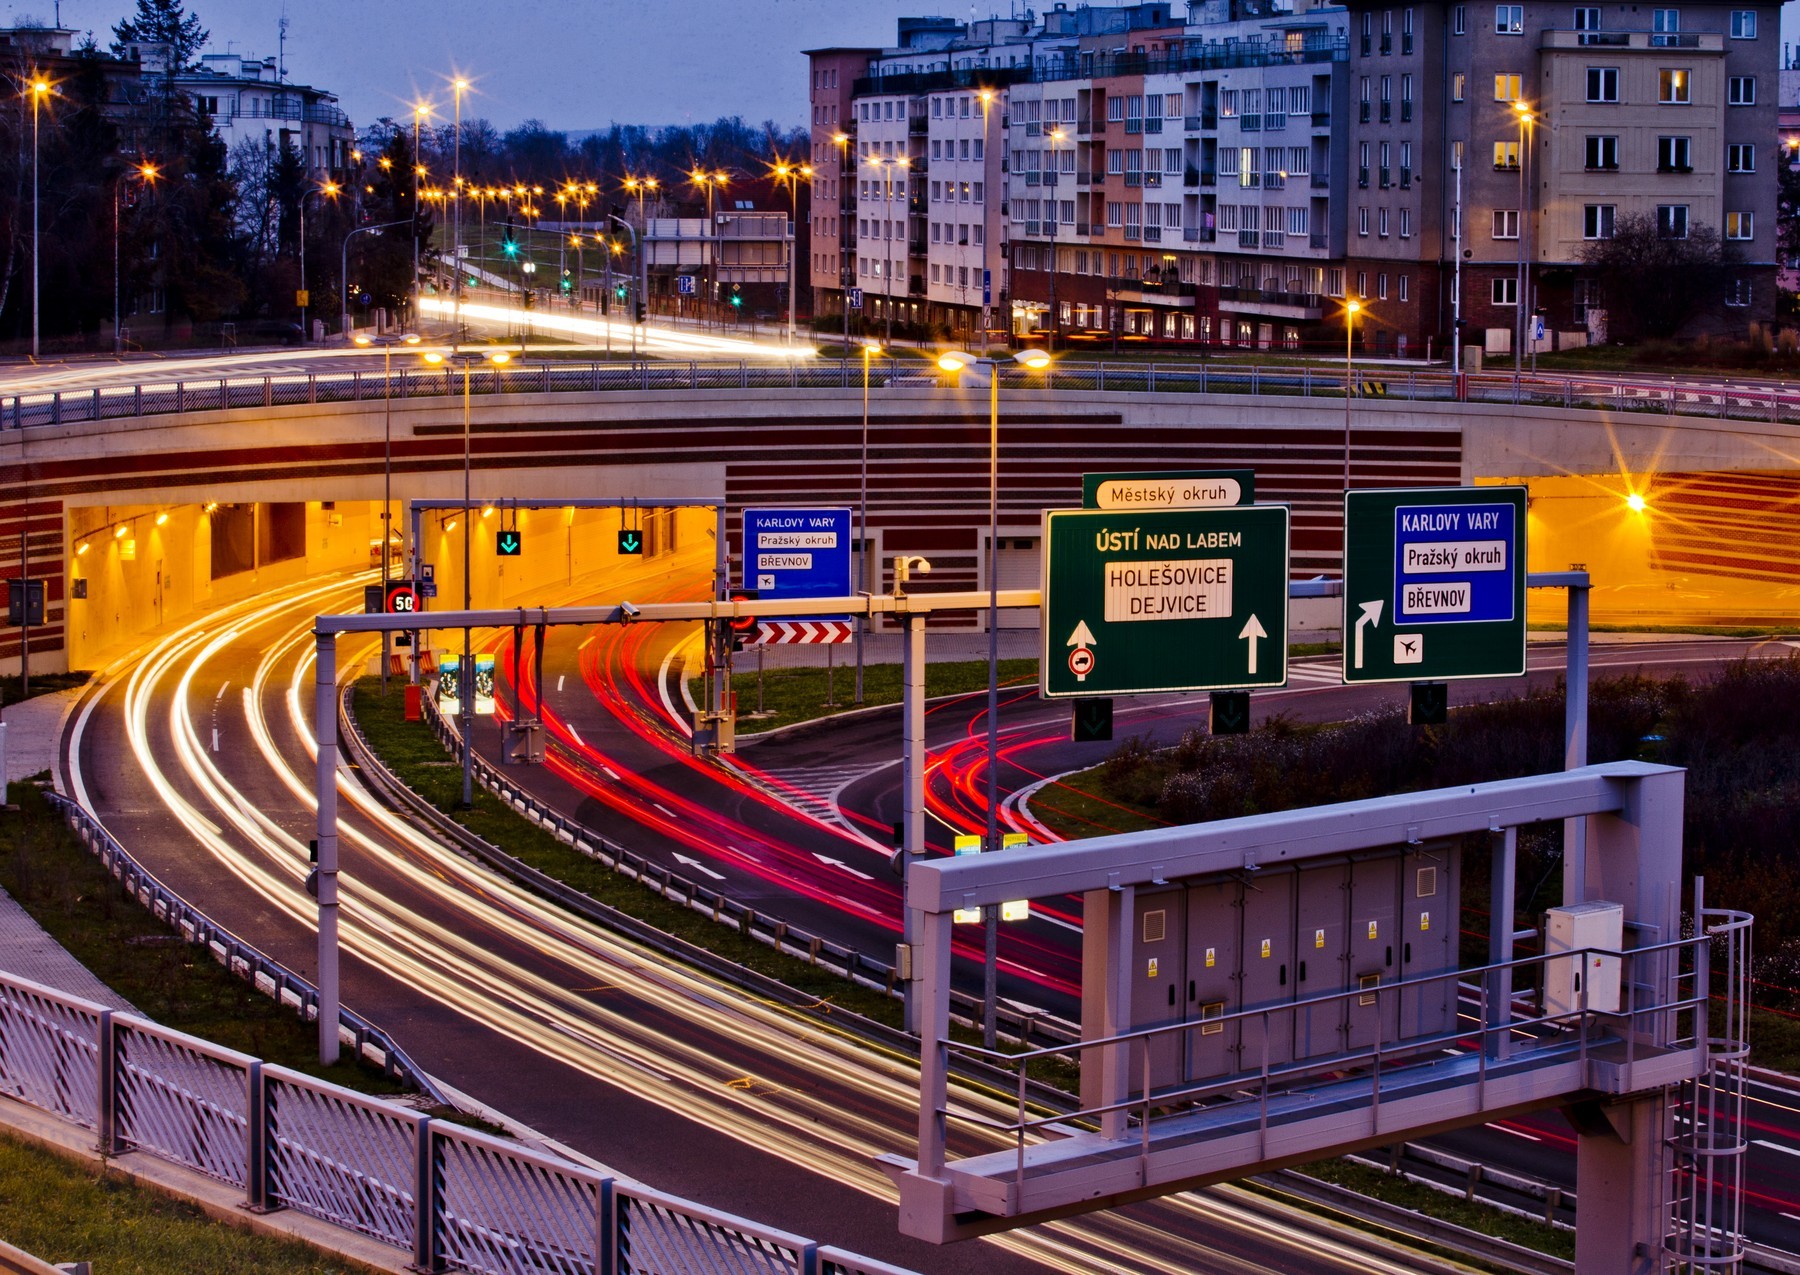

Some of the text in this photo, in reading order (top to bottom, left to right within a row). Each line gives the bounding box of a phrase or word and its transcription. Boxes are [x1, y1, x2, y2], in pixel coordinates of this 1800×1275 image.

[1111, 485, 1227, 505] Městský okruh
[756, 518, 835, 528] KARLOVY VARY
[1402, 512, 1500, 532] KARLOVY VARY
[760, 535, 834, 547] Pražský okruh
[1096, 527, 1242, 552] ÚSTÍ NAD LABEM
[760, 555, 809, 567] BŘEVNOV
[1408, 547, 1501, 569] Pražský okruh
[1110, 563, 1227, 587] HOLEŠOVICE
[395, 596, 413, 611] 50
[1130, 594, 1207, 615] DEJVICE
[1408, 587, 1466, 608] BŘEVNOV
